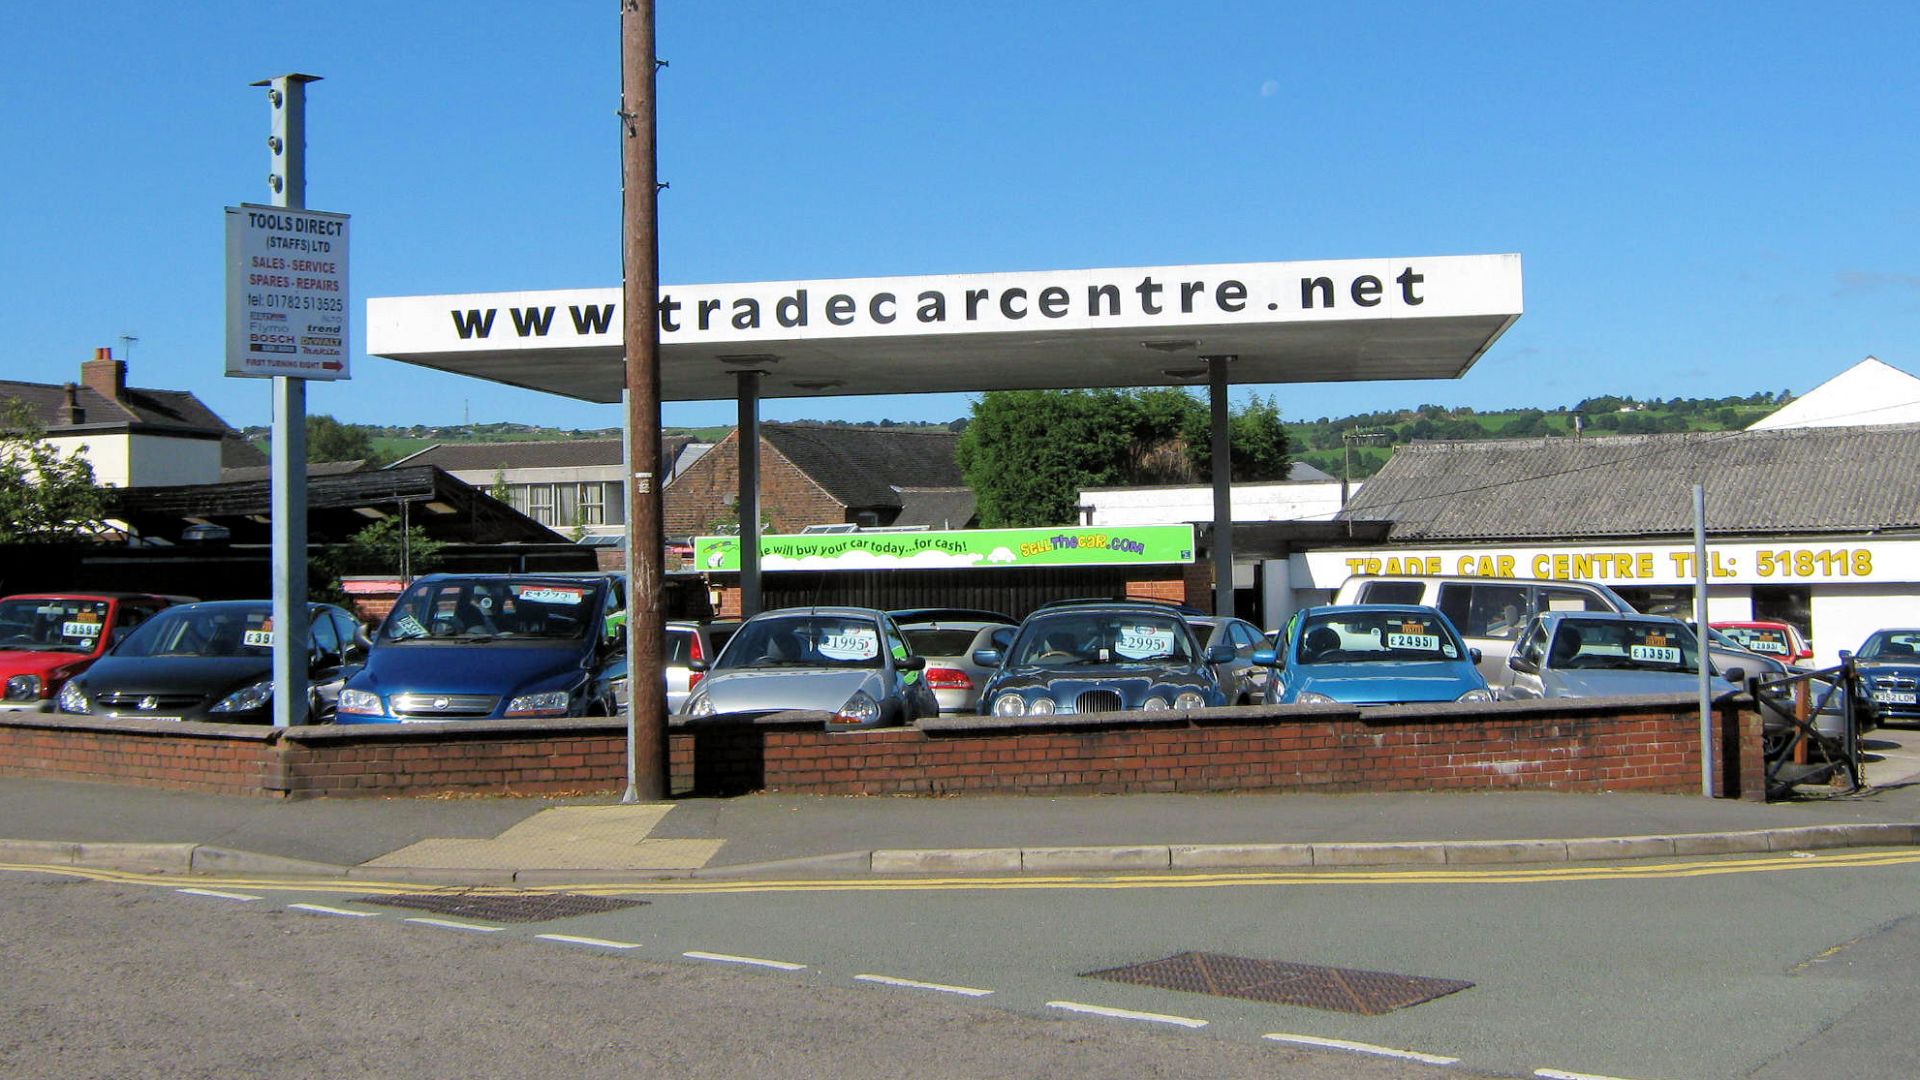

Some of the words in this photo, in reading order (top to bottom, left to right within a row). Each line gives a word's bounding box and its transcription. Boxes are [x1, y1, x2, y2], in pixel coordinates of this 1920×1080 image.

[248, 212, 293, 232] TOOLS
[295, 218, 343, 237] DIRECT
[266, 236, 310, 254] (STAFFS)
[312, 240, 331, 254] LTD
[251, 256, 286, 270] SALES
[291, 259, 336, 274] SERVICE
[249, 273, 290, 288] SPARES
[296, 277, 340, 292] REPAIRS
[266, 294, 301, 309] 01782
[303, 296, 343, 313] 513525
[451, 266, 1425, 339] wwwtradecarcentre.net
[307, 324, 341, 334] trend
[250, 333, 296, 344] BOSCH
[773, 544, 793, 556] will
[796, 544, 818, 556] buy
[820, 541, 847, 555] your
[850, 538, 869, 548] car
[935, 538, 968, 553] cash!
[1345, 556, 1442, 576] TRADE
[1456, 554, 1517, 578] CAR
[1531, 553, 1654, 580] CENTRE
[1755, 548, 1873, 578] 518118
